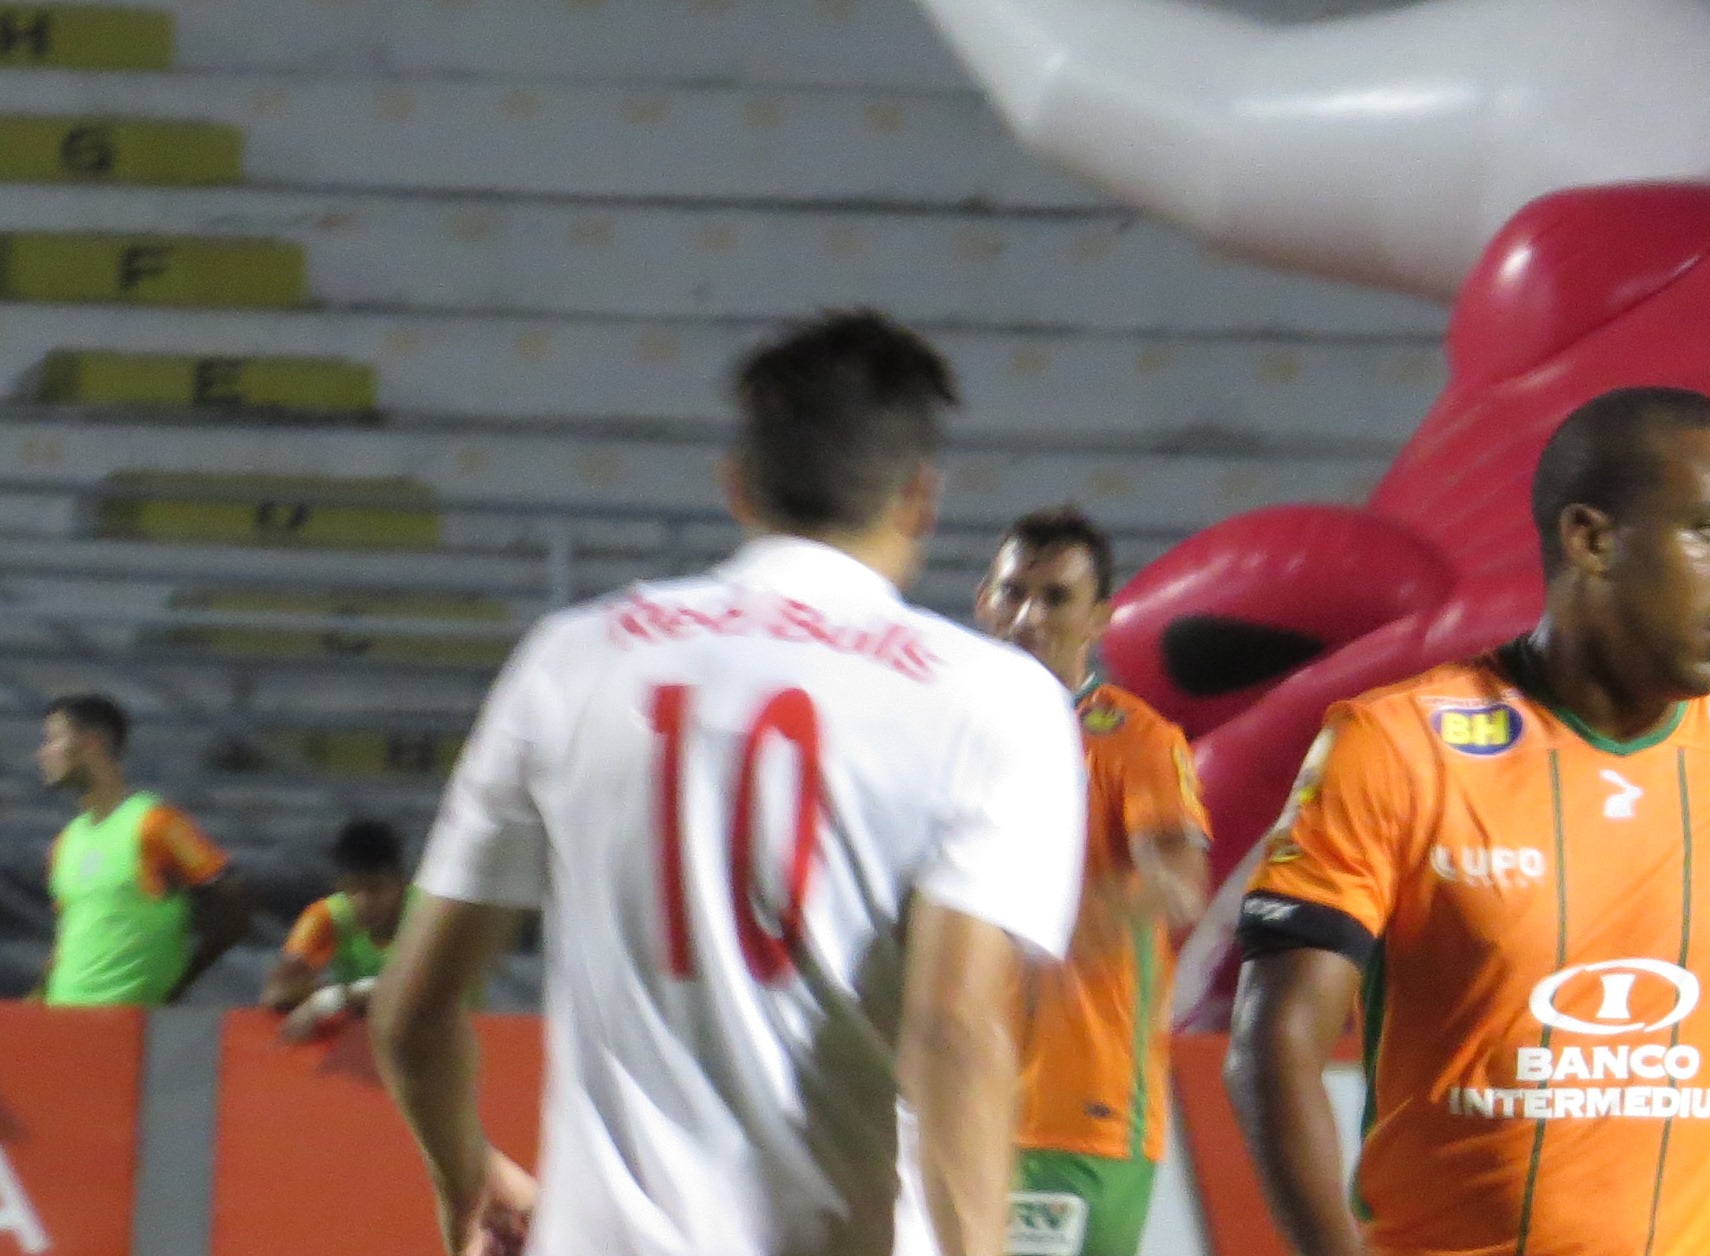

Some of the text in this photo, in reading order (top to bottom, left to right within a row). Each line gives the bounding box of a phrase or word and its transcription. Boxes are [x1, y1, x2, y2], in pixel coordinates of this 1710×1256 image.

[1440, 710, 1510, 746] BH
[645, 684, 822, 987] 10
[1516, 1044, 1701, 1082] BANCO
